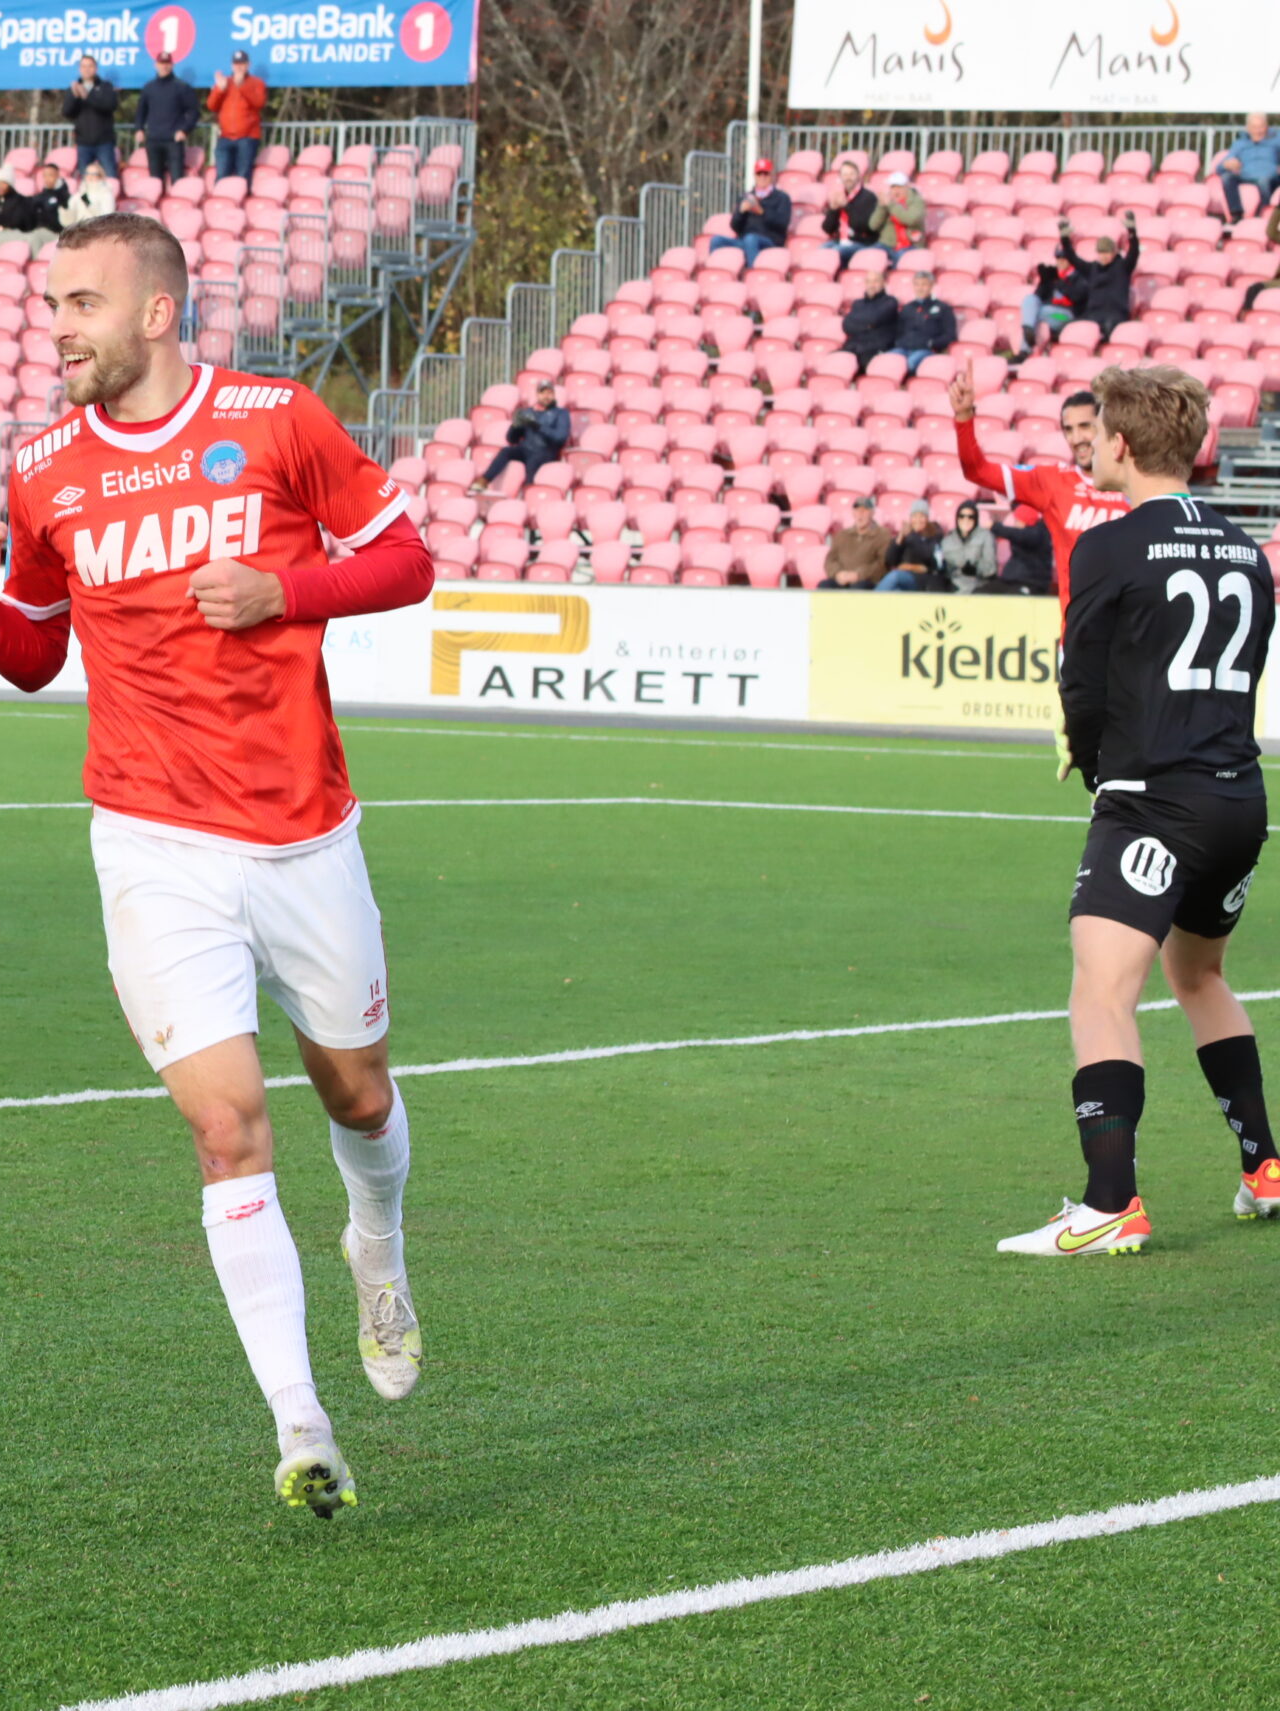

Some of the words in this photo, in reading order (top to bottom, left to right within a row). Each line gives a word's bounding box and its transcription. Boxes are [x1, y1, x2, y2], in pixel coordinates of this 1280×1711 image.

[159, 16, 180, 54] 1
[231, 3, 396, 47] SpareBank
[415, 12, 434, 51] 1
[19, 47, 140, 67] ØSTLANDET
[270, 43, 395, 64] ØSTLANDET
[824, 31, 964, 88] Manis
[1049, 31, 1192, 90] Manis
[54, 505, 83, 518] umbro
[73, 492, 263, 587] MAPEI
[1147, 543, 1197, 561] JENSEN
[1200, 544, 1211, 559] &
[1166, 569, 1253, 693] 22
[616, 641, 631, 658] &
[649, 642, 763, 661] interiør
[901, 630, 1061, 690] kjelds
[961, 702, 1052, 720] ORDENTLIG
